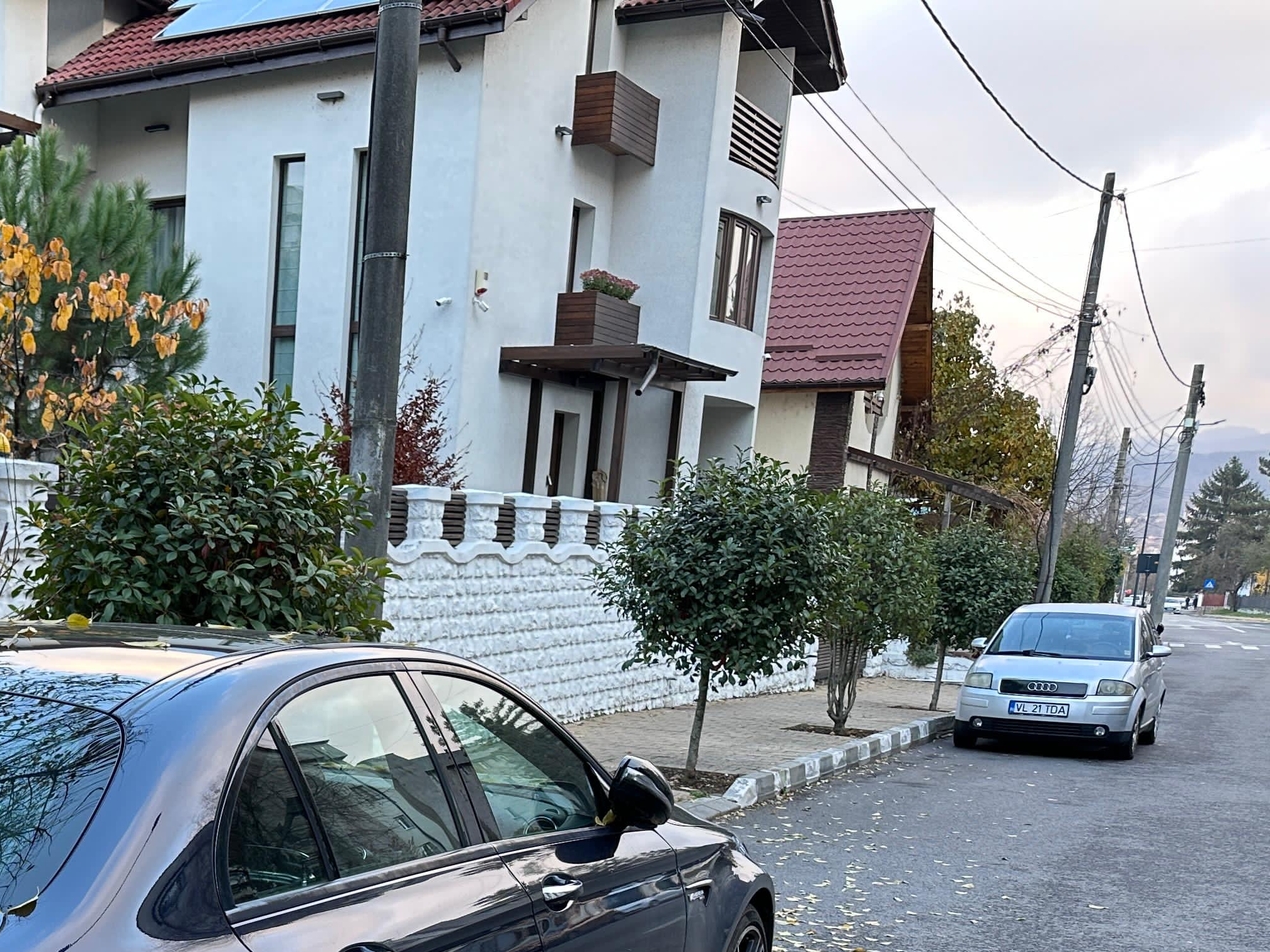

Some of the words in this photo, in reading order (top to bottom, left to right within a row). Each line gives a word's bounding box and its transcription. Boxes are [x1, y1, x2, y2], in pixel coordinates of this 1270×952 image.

[1016, 703, 1028, 713] VL
[1032, 704, 1042, 713] 21
[1045, 704, 1066, 715] TDA
